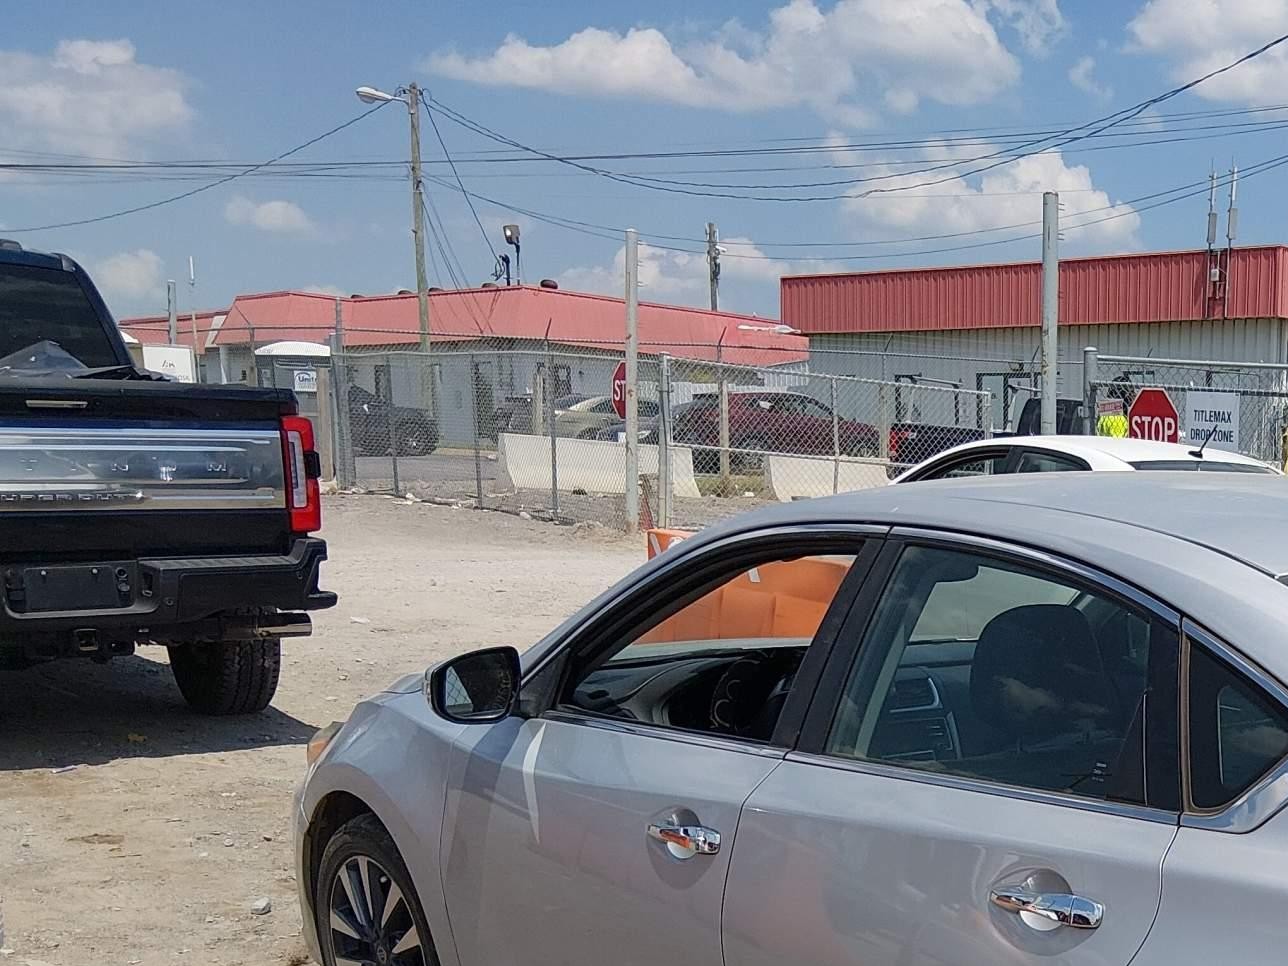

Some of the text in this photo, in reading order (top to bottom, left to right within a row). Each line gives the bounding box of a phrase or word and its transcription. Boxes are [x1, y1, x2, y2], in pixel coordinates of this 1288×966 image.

[614, 379, 626, 401] ST
[1193, 409, 1232, 424] TITLEMAX
[1131, 415, 1176, 443] STOP
[1190, 428, 1234, 443] DROP ZONE
